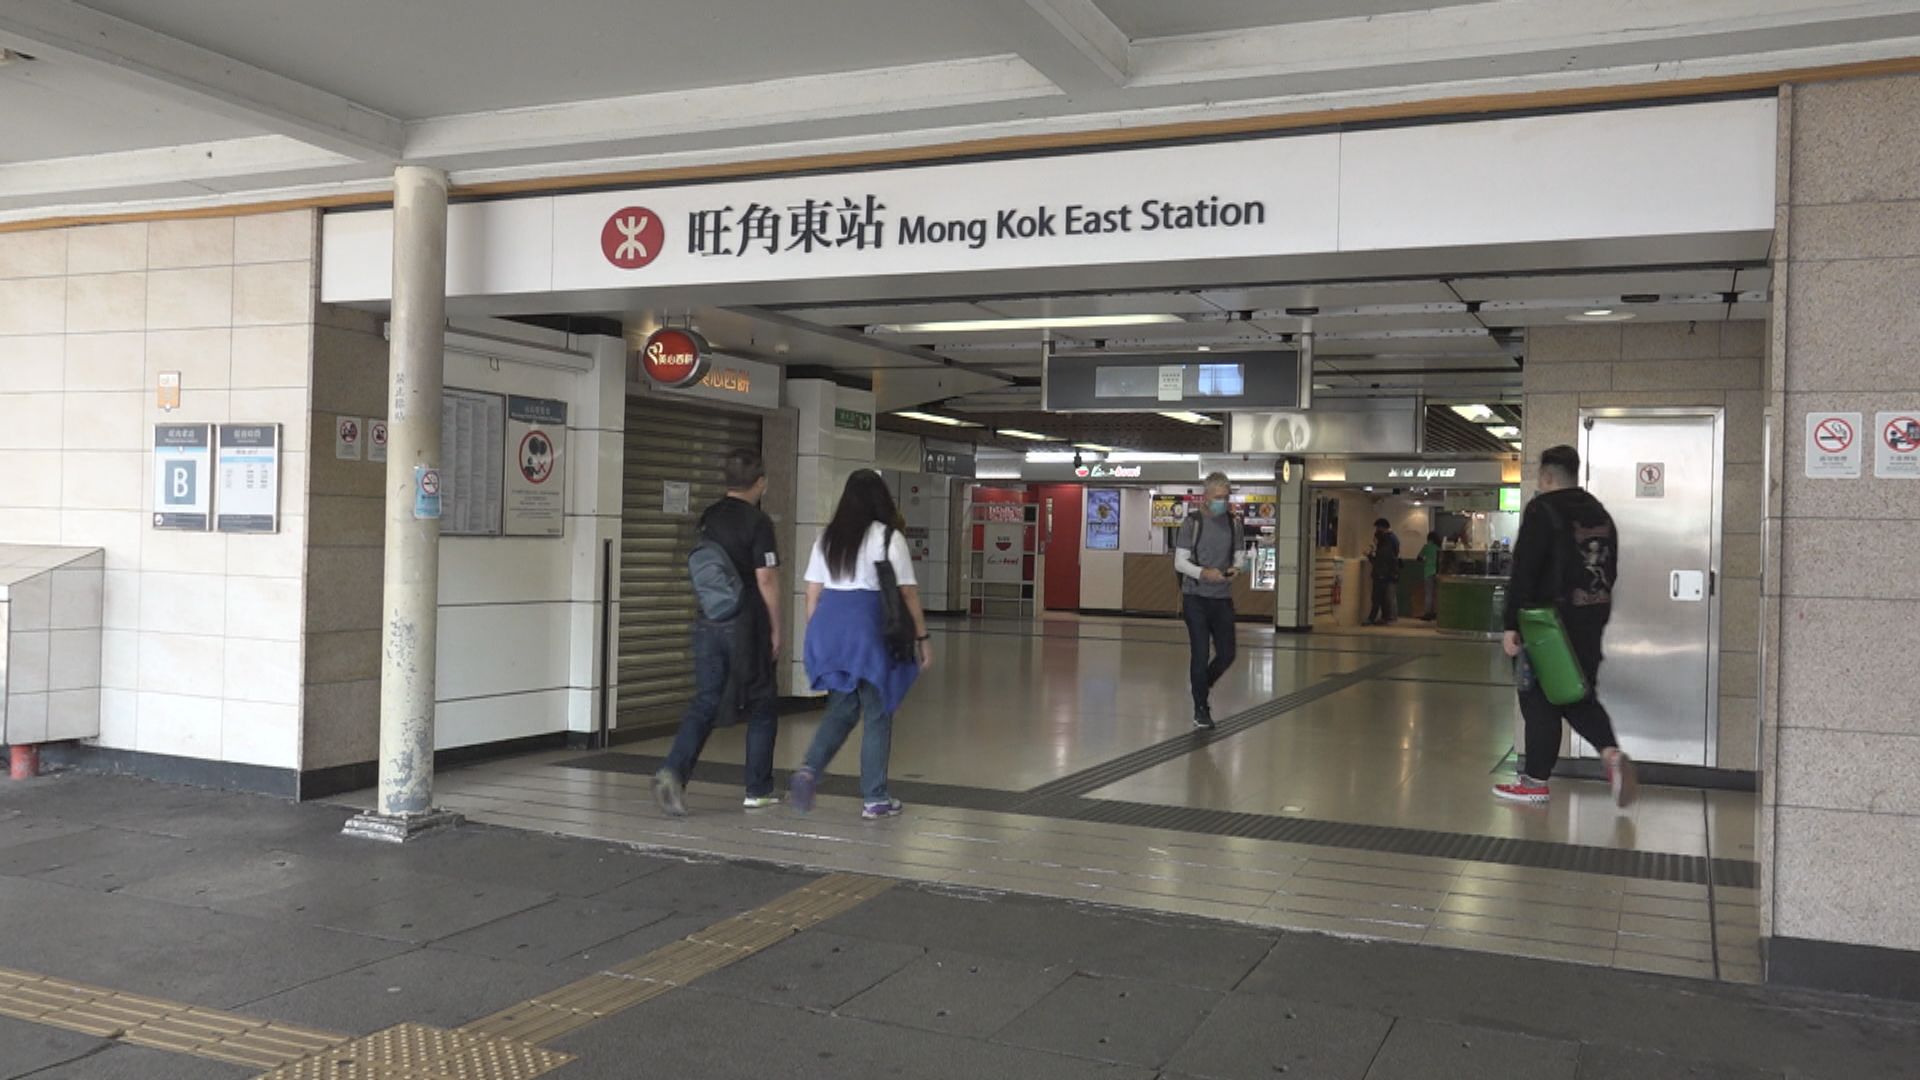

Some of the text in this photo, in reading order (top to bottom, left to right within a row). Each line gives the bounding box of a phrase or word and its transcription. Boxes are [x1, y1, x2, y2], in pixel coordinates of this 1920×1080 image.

[688, 195, 1265, 257] 旺角東站 Mong Kok East Station
[173, 468, 189, 498] B
